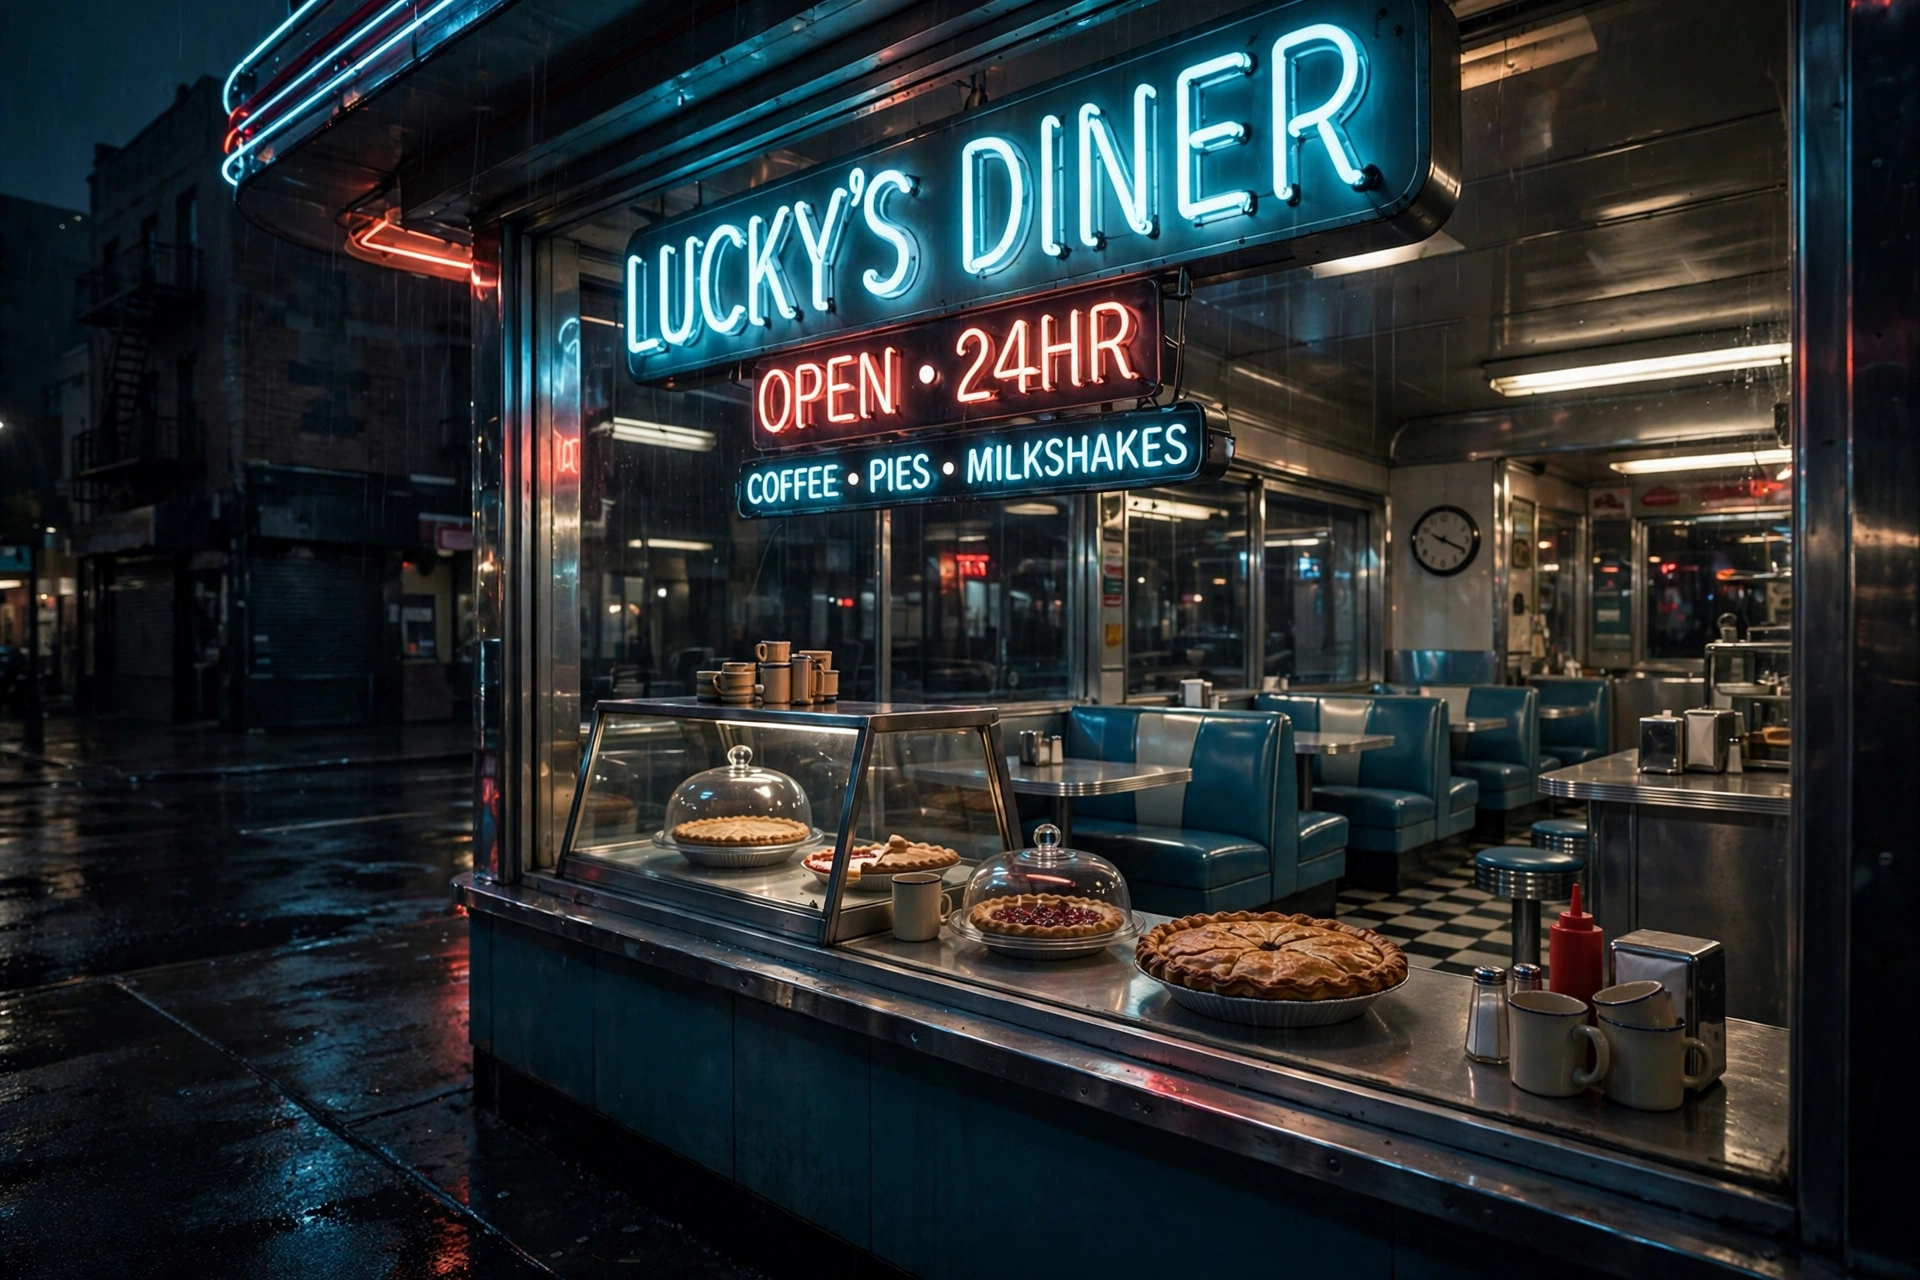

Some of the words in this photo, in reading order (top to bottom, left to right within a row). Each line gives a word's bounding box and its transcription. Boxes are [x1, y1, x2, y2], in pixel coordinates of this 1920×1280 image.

[627, 167, 913, 353] LUCKY'S
[962, 23, 1370, 275] DINER
[758, 346, 898, 434] OPEN
[956, 301, 1139, 403] 24HR
[747, 464, 839, 505] COFFEE
[869, 453, 930, 494] PIES
[967, 423, 1188, 484] MILKSHAKES
